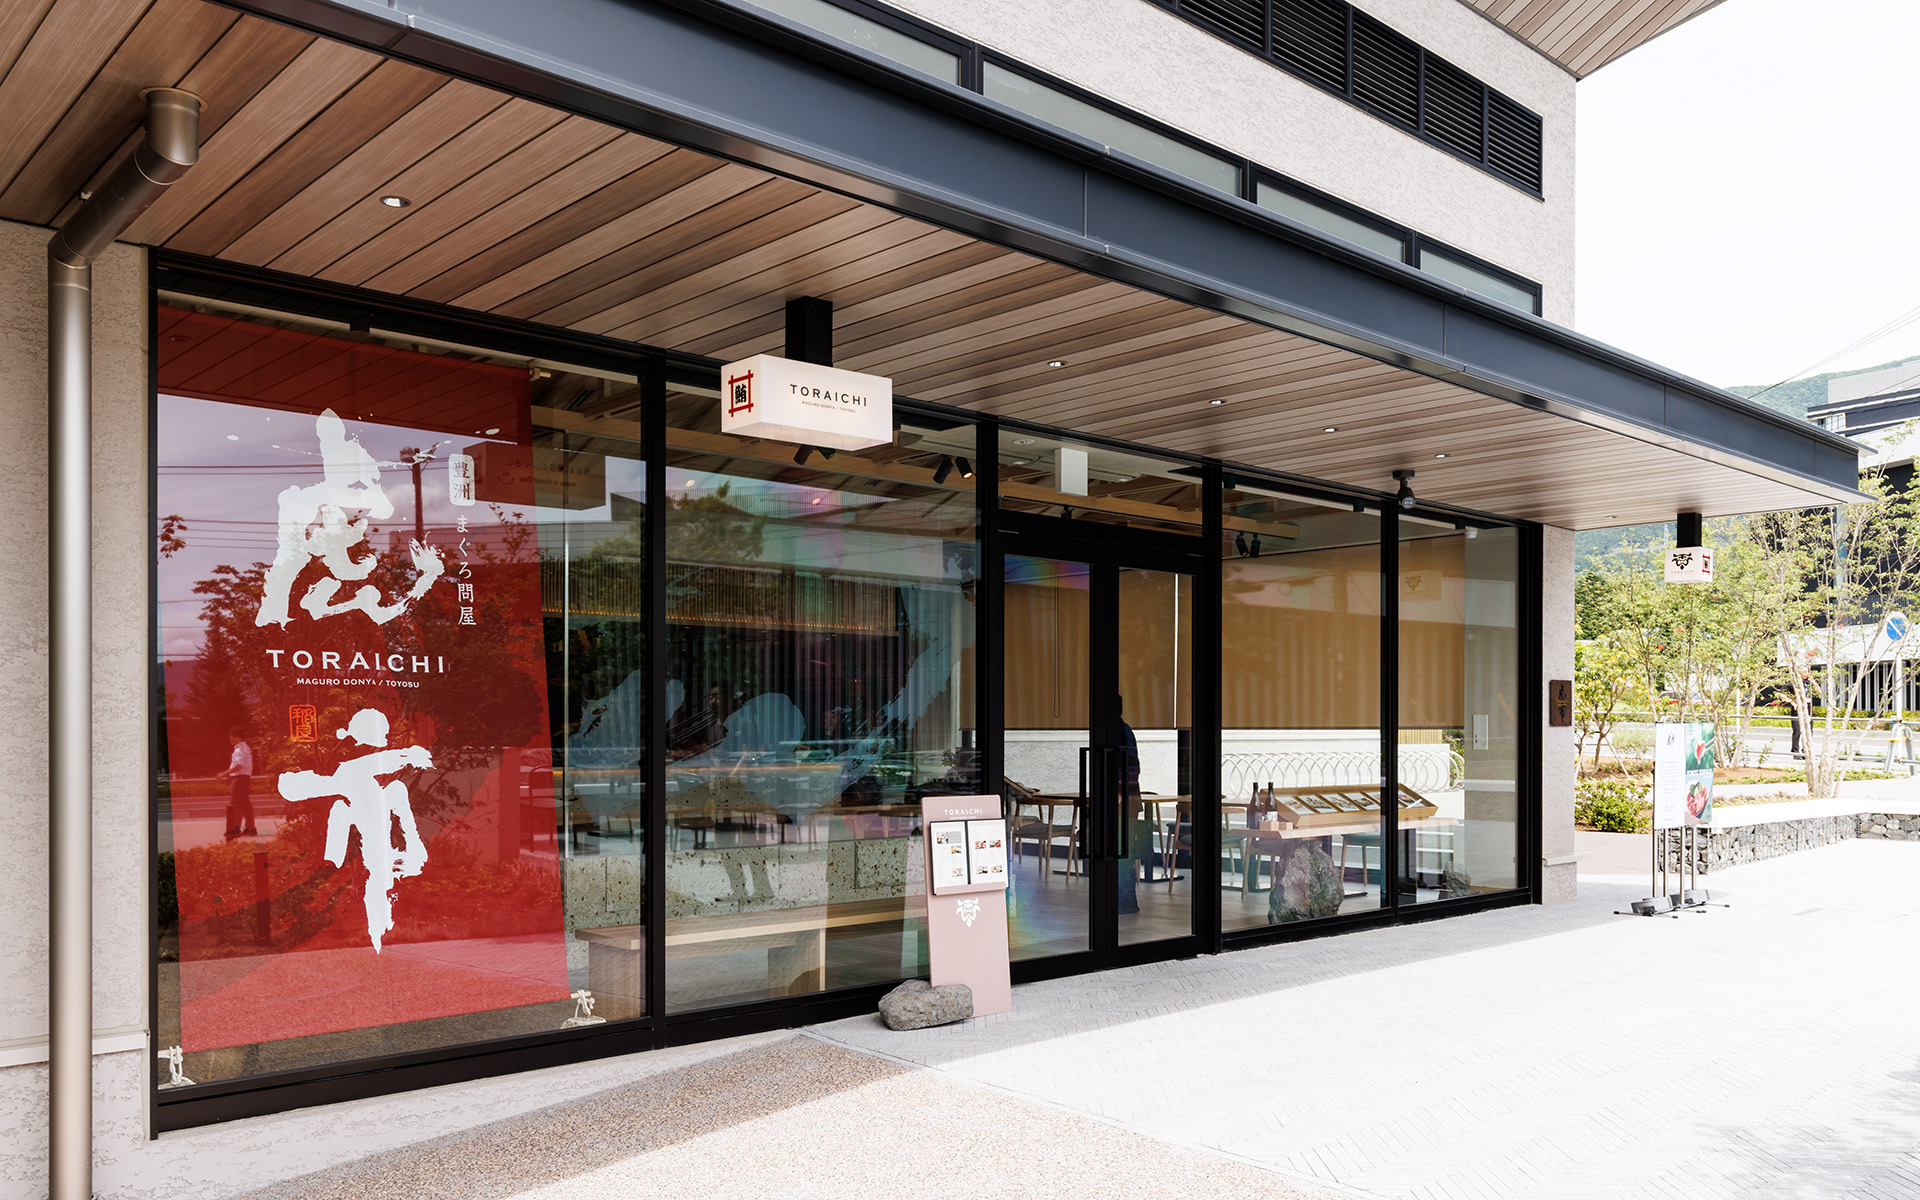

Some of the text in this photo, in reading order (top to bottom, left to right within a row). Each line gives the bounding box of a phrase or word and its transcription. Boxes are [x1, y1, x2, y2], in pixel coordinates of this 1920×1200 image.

[735, 383, 747, 405] 鮪
[789, 383, 868, 407] TORAICHI
[801, 400, 820, 408] MAGURO
[453, 460, 477, 626] 豊洲 まぐろ問屋
[265, 649, 445, 674] TORAICHI
[296, 677, 341, 687] MAGURO
[343, 678, 377, 687] DONYA
[385, 679, 420, 689] TOYOSU
[943, 808, 983, 816] TORAICHI
[277, 708, 436, 954] 市
